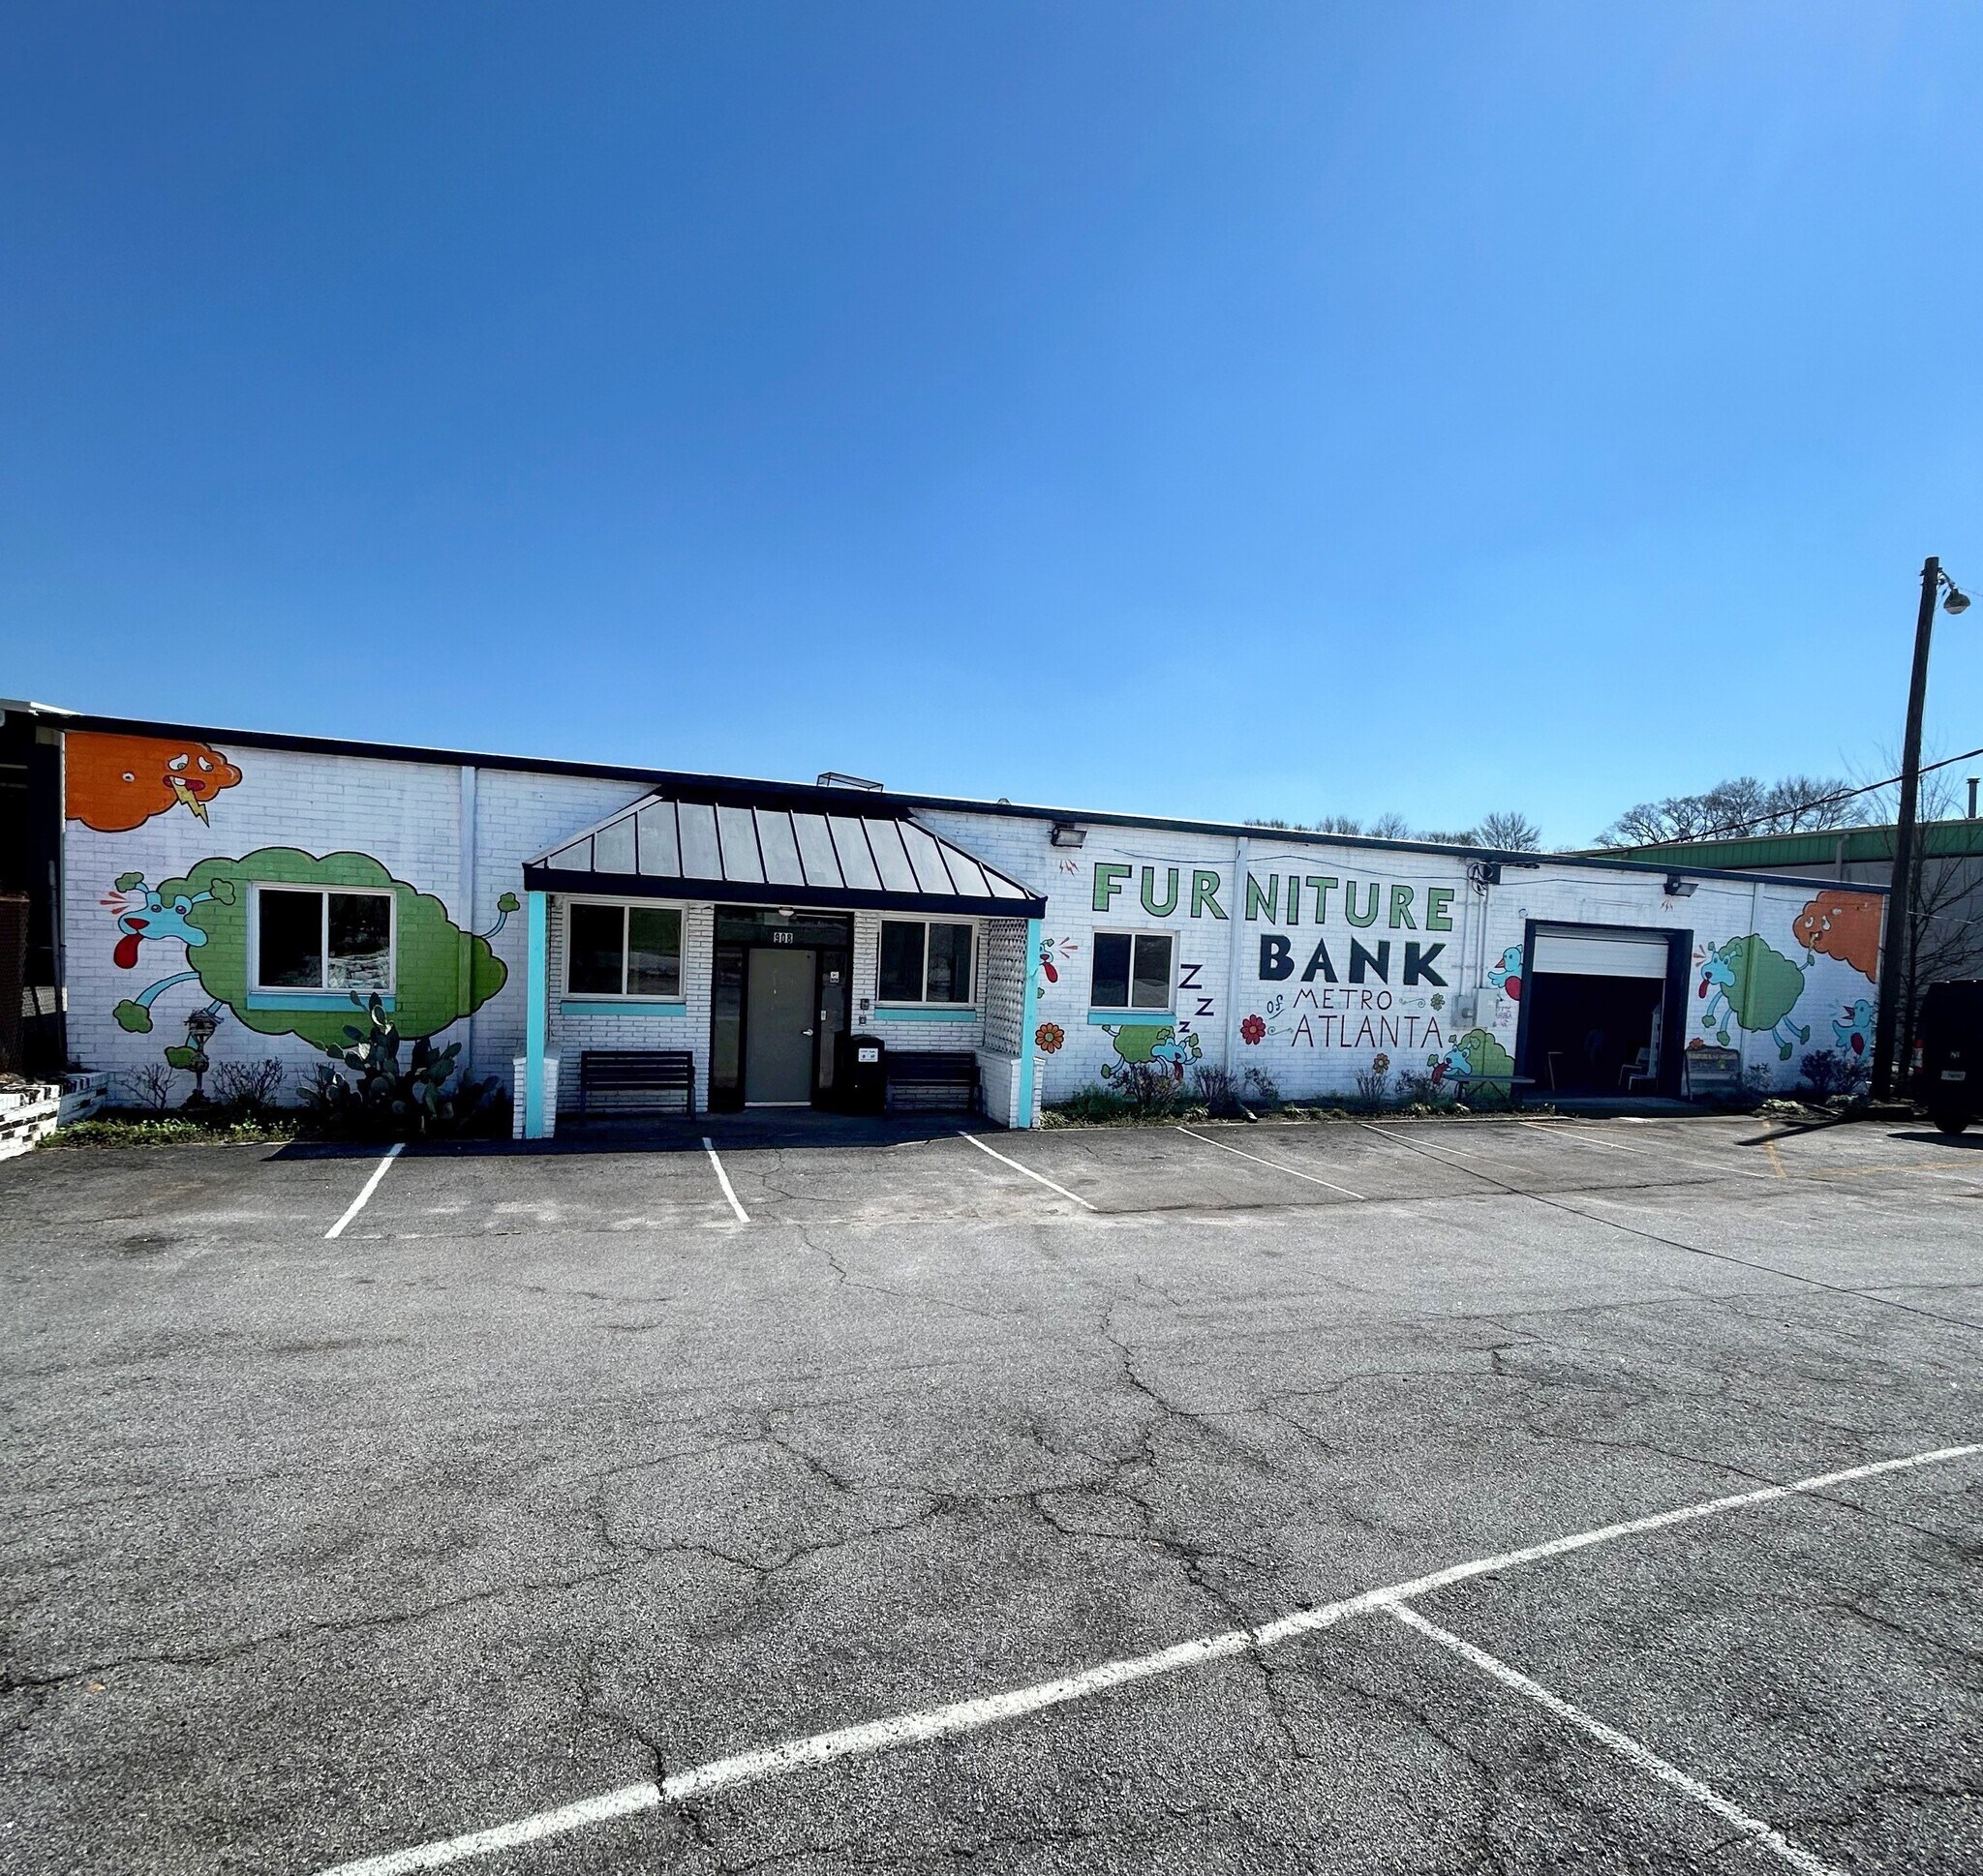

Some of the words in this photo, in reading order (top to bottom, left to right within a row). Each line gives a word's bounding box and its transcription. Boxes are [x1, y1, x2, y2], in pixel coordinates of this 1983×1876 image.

[1092, 862, 1455, 932] FURNITURE
[774, 932, 793, 944] 908
[1259, 933, 1449, 987] BANK
[1293, 988, 1392, 1011] METRO
[1291, 1014, 1444, 1048] ATLANTA
